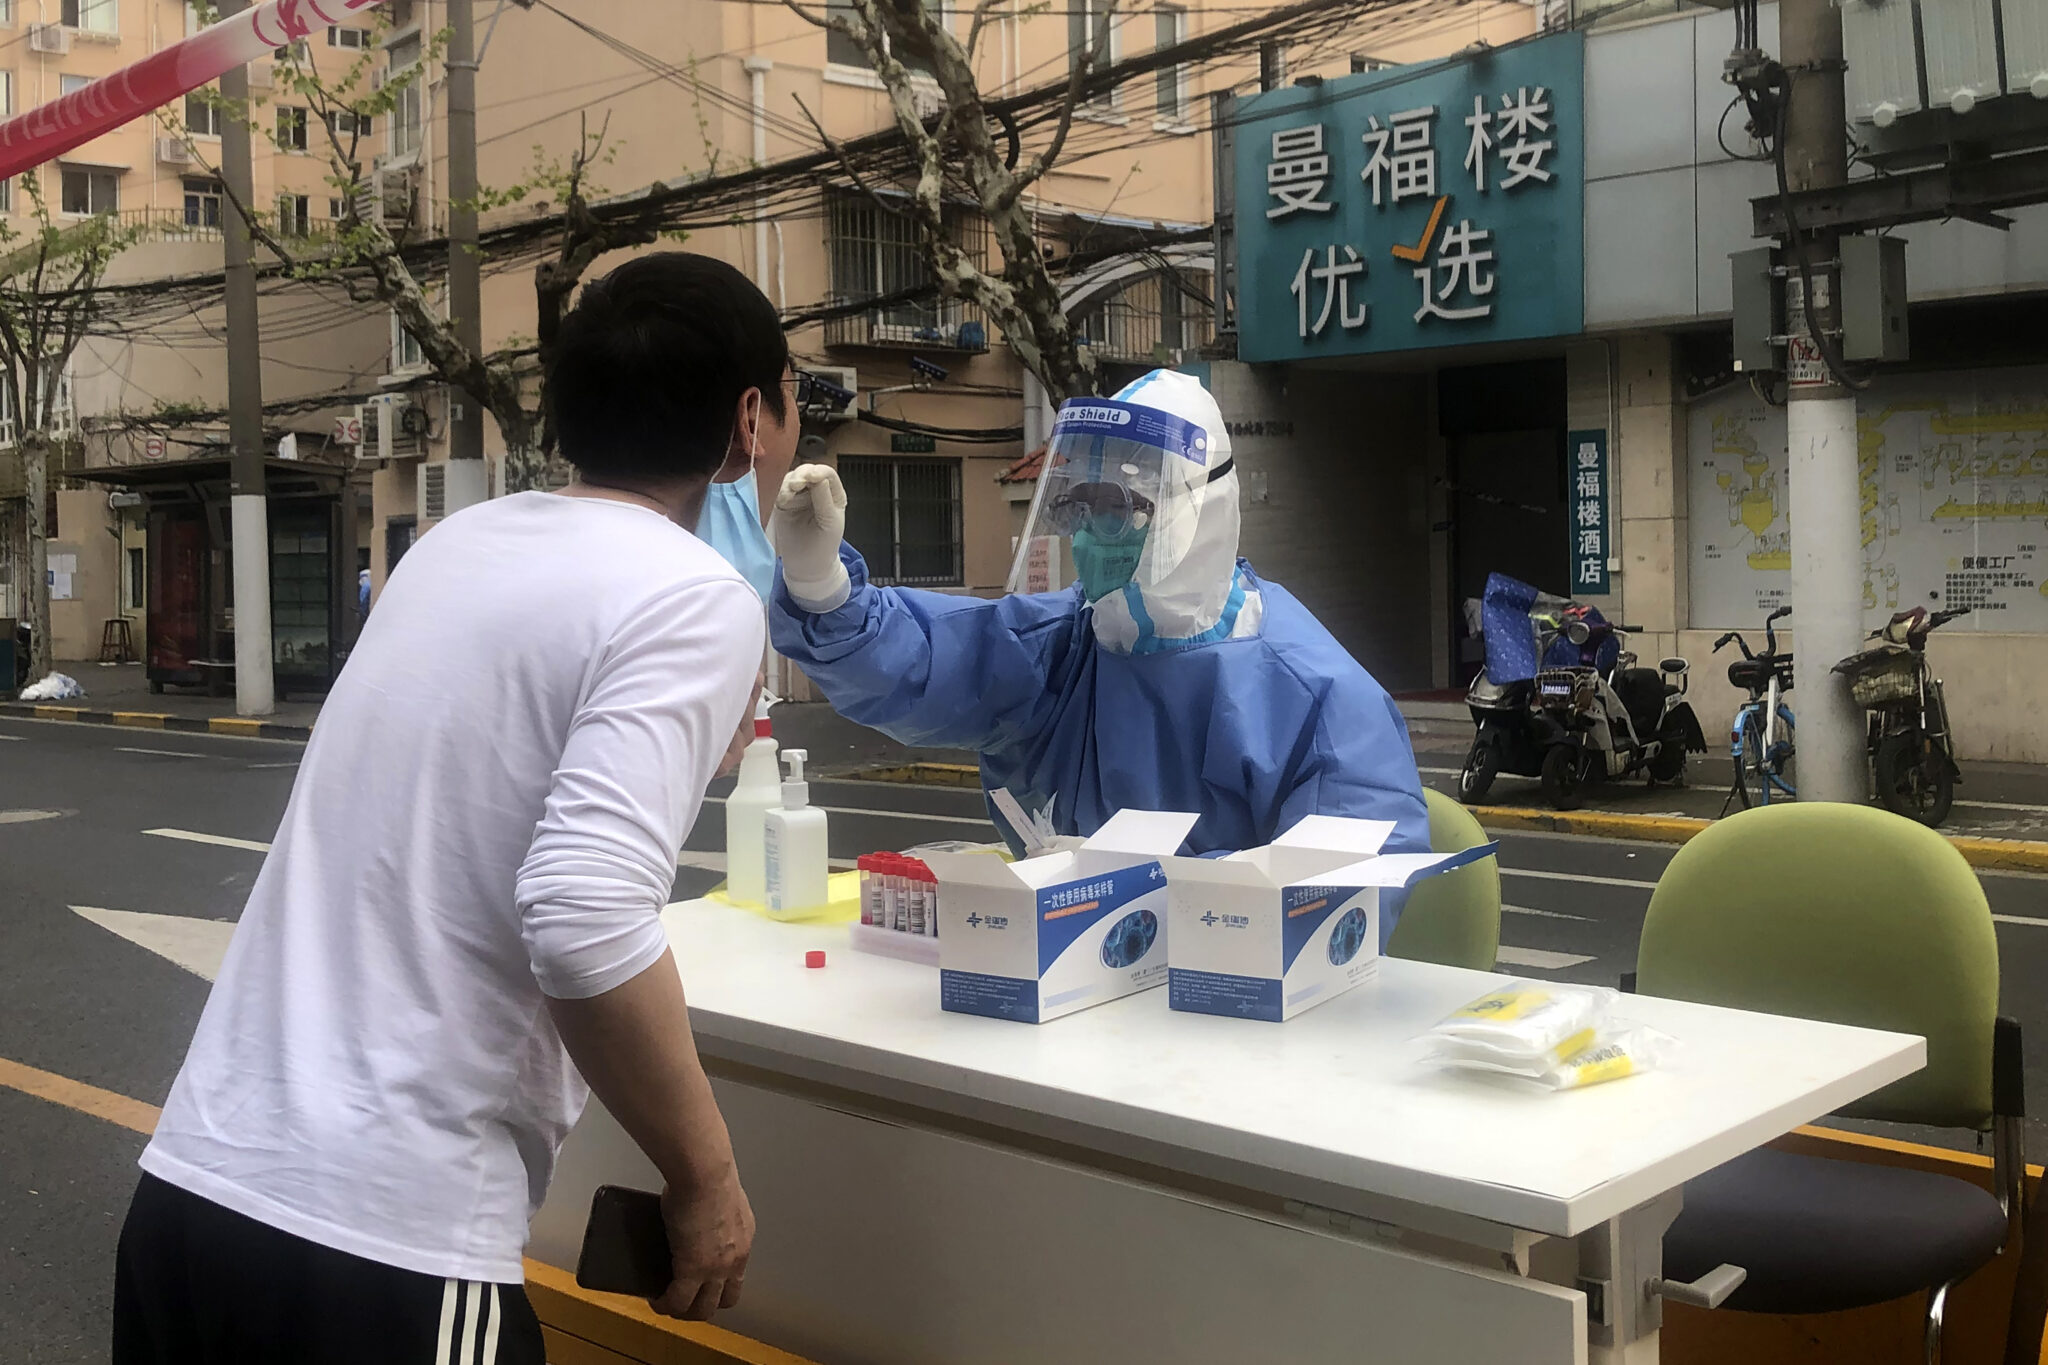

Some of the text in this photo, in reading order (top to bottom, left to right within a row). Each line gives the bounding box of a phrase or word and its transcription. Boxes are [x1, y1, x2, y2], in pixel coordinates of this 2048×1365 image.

[1265, 86, 1553, 219] 曼福楼
[1290, 219, 1495, 337] 优选
[1079, 408, 1121, 422] Shield
[1577, 442, 1601, 584] 曼福楼酒店
[1044, 880, 1114, 909] 一次性使用病毒采样管
